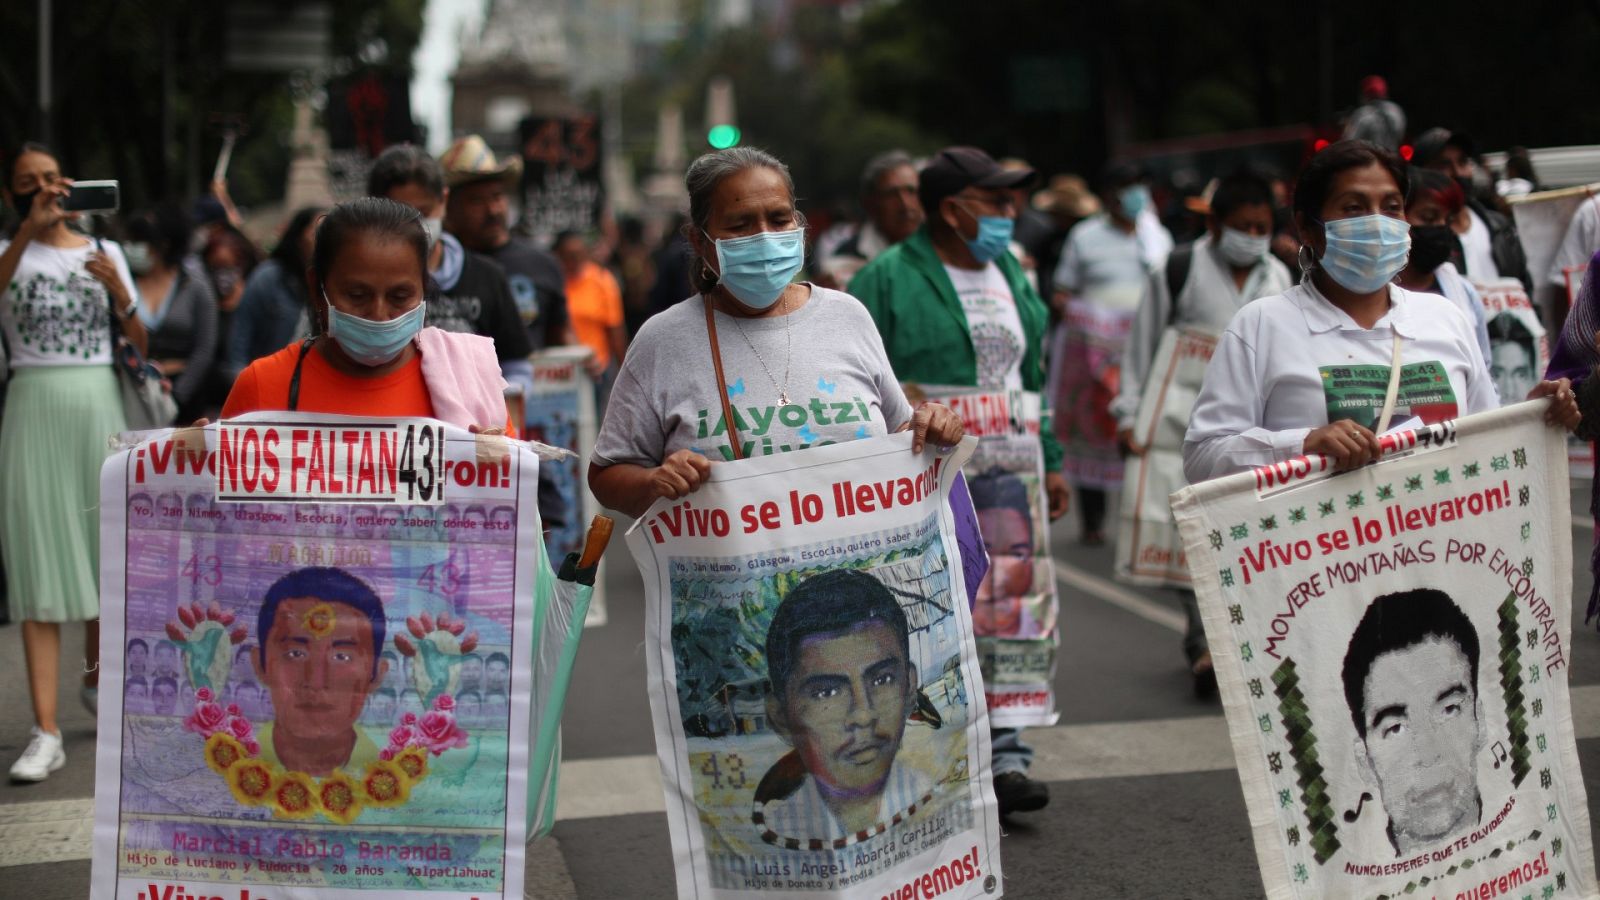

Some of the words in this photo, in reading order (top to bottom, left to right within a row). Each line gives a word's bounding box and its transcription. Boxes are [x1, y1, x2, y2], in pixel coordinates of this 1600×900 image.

[697, 396, 873, 439] ¡Ayotzi
[219, 428, 280, 494] NOS
[290, 429, 397, 495] FALTAN
[399, 424, 444, 501] 43!
[134, 506, 155, 518] Yo,
[162, 507, 184, 517] Jan
[234, 511, 288, 523] Glasgow,
[295, 513, 348, 525] Escocia,
[356, 517, 400, 530] quiero
[647, 500, 731, 544] ¡Vivo
[740, 501, 781, 534] se
[789, 490, 824, 526] lo
[831, 457, 943, 518] llevaron!
[1238, 538, 1313, 585] ¡Vivo
[1316, 528, 1351, 556] se
[1352, 515, 1384, 547] lo
[1385, 479, 1512, 537] llevaron!
[747, 555, 796, 569] Glasgow,
[886, 533, 911, 545] saber
[181, 555, 224, 587] 43
[416, 564, 463, 596] 43
[1263, 572, 1326, 661] MOVERE
[1325, 540, 1437, 588] MONTAÑAS
[1445, 539, 1487, 564] POR
[1488, 547, 1567, 678] ENCONTRARTE
[701, 753, 748, 790] 43
[172, 832, 262, 856] Marcial
[277, 837, 345, 861] Pablo
[357, 841, 452, 861] Baranda
[755, 861, 791, 877] Luis
[800, 858, 847, 879] Angel
[854, 840, 896, 869] Abarca
[901, 817, 946, 846] Carillo
[1344, 861, 1383, 876] NUNCA
[1384, 854, 1430, 876] ESPERES
[1432, 845, 1454, 863] QUE
[1452, 837, 1469, 854] TE
[1470, 795, 1516, 844] OLVIDEMOS
[127, 853, 157, 866] Hijo
[164, 856, 179, 866] de
[186, 857, 236, 870] Luciano
[243, 862, 251, 873] y
[258, 860, 310, 873] Eudocia
[332, 864, 347, 875] 20
[354, 866, 384, 876] años
[407, 865, 496, 880] Xalpatlahuac
[744, 879, 768, 890] Hijo
[772, 879, 783, 889] de
[828, 880, 834, 890] y
[884, 858, 892, 868] 18
